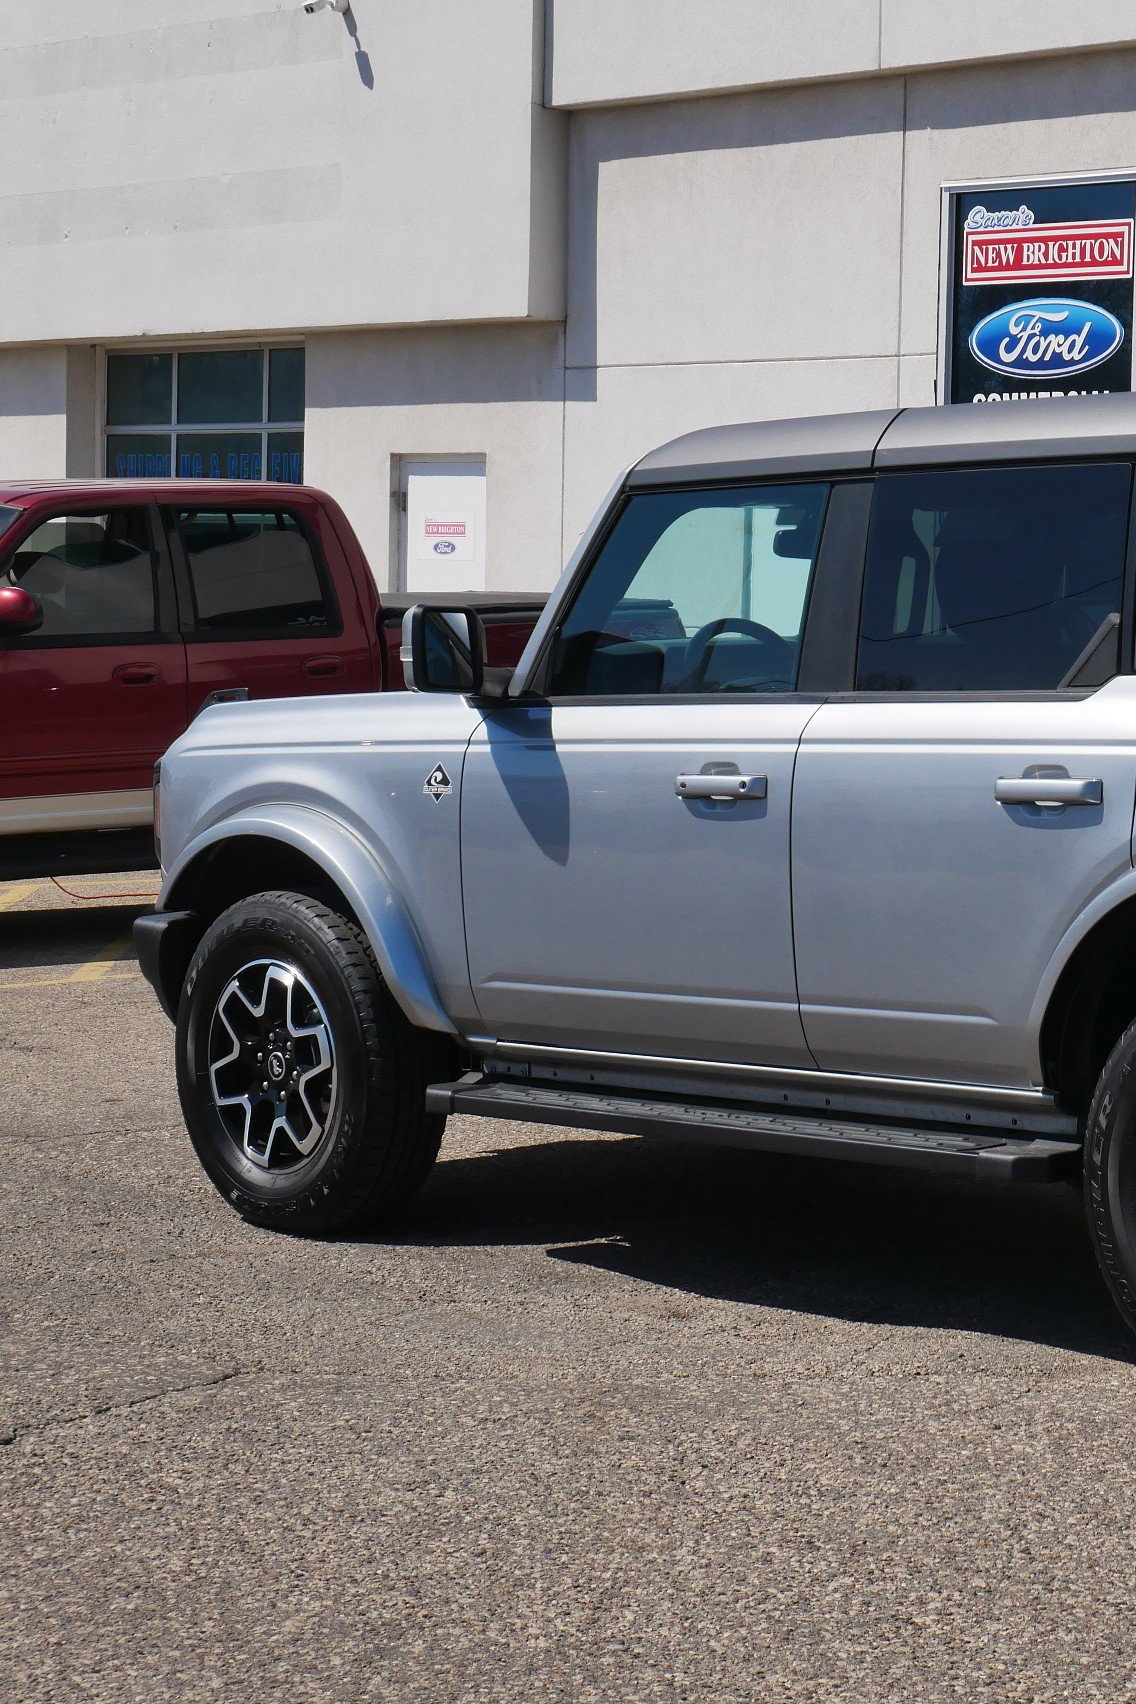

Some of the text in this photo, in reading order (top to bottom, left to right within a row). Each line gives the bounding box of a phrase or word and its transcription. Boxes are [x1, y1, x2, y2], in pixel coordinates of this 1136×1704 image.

[966, 206, 1033, 230] Saxon's
[973, 238, 1122, 268] NEW BRIGHTON
[999, 310, 1093, 363] Ford
[426, 525, 465, 533] NEW BRIGHTON
[436, 541, 453, 553] Ford
